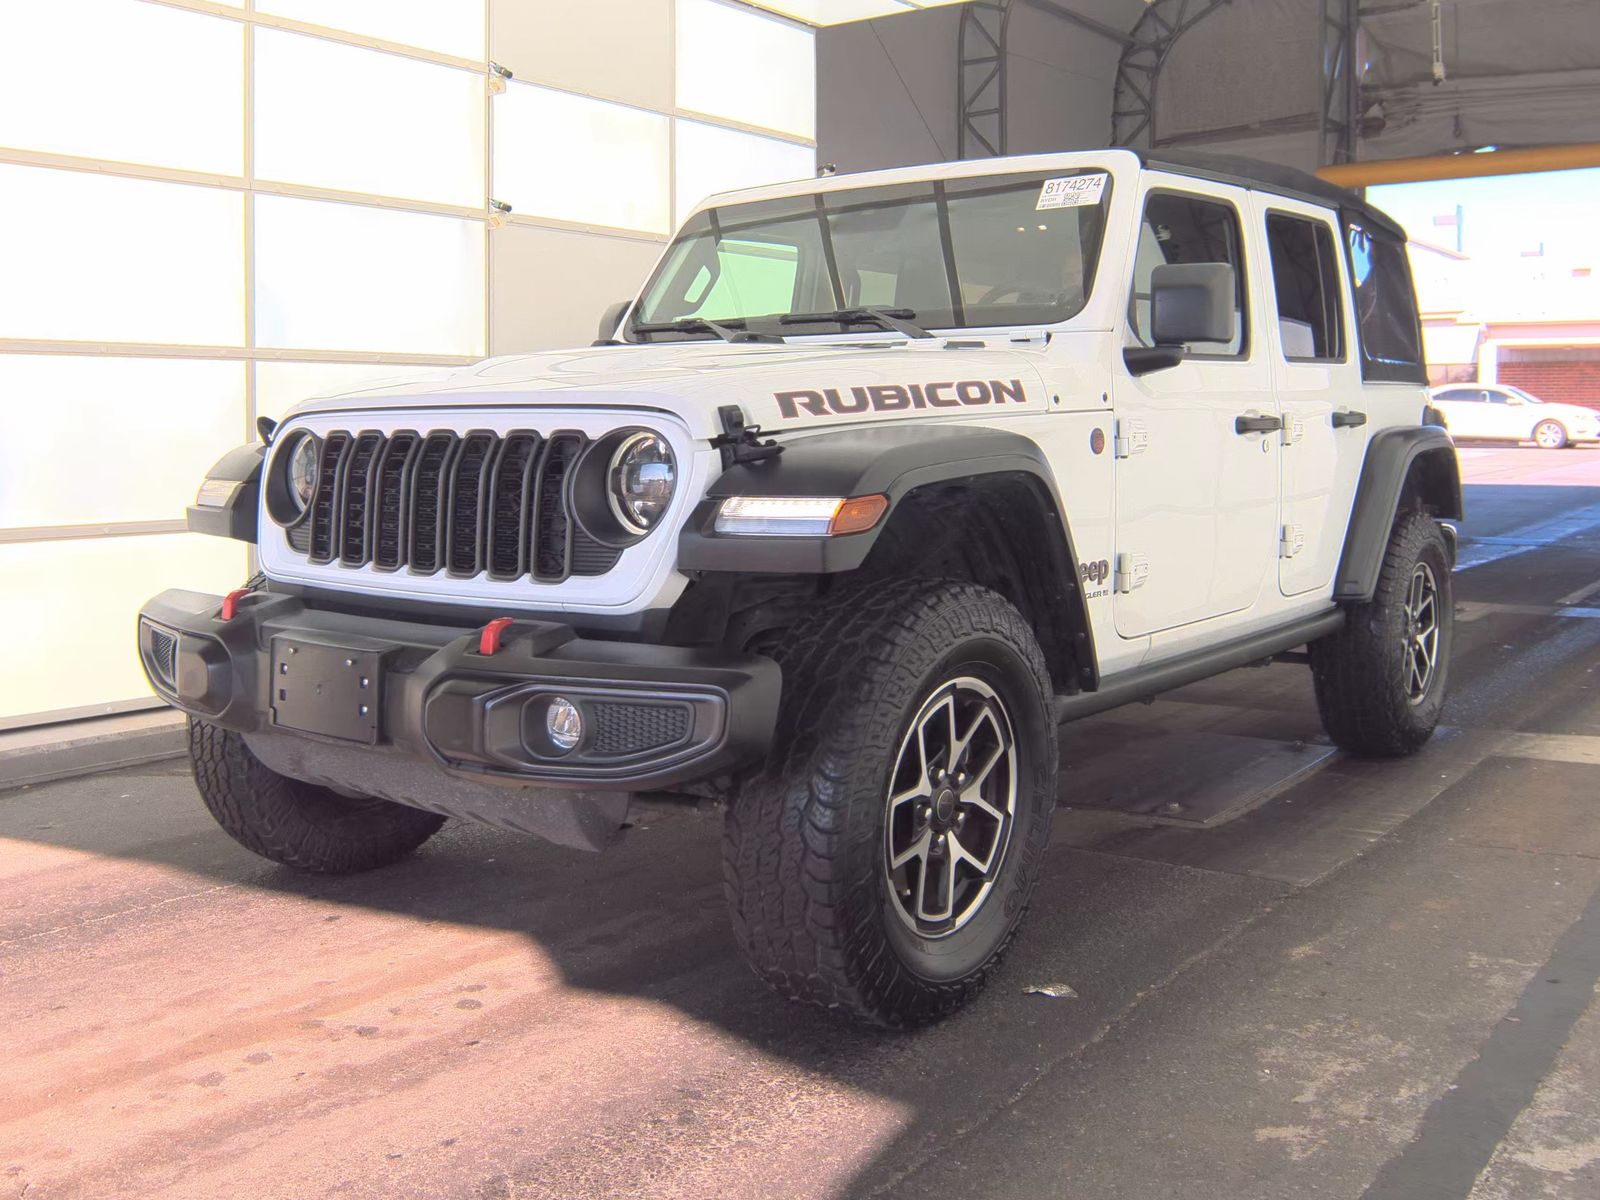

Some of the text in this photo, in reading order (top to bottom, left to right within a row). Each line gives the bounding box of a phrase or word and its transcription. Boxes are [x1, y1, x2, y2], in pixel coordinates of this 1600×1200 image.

[1045, 177, 1101, 194] 8174274
[774, 379, 1026, 418] RUBICON
[1079, 559, 1110, 585] eep
